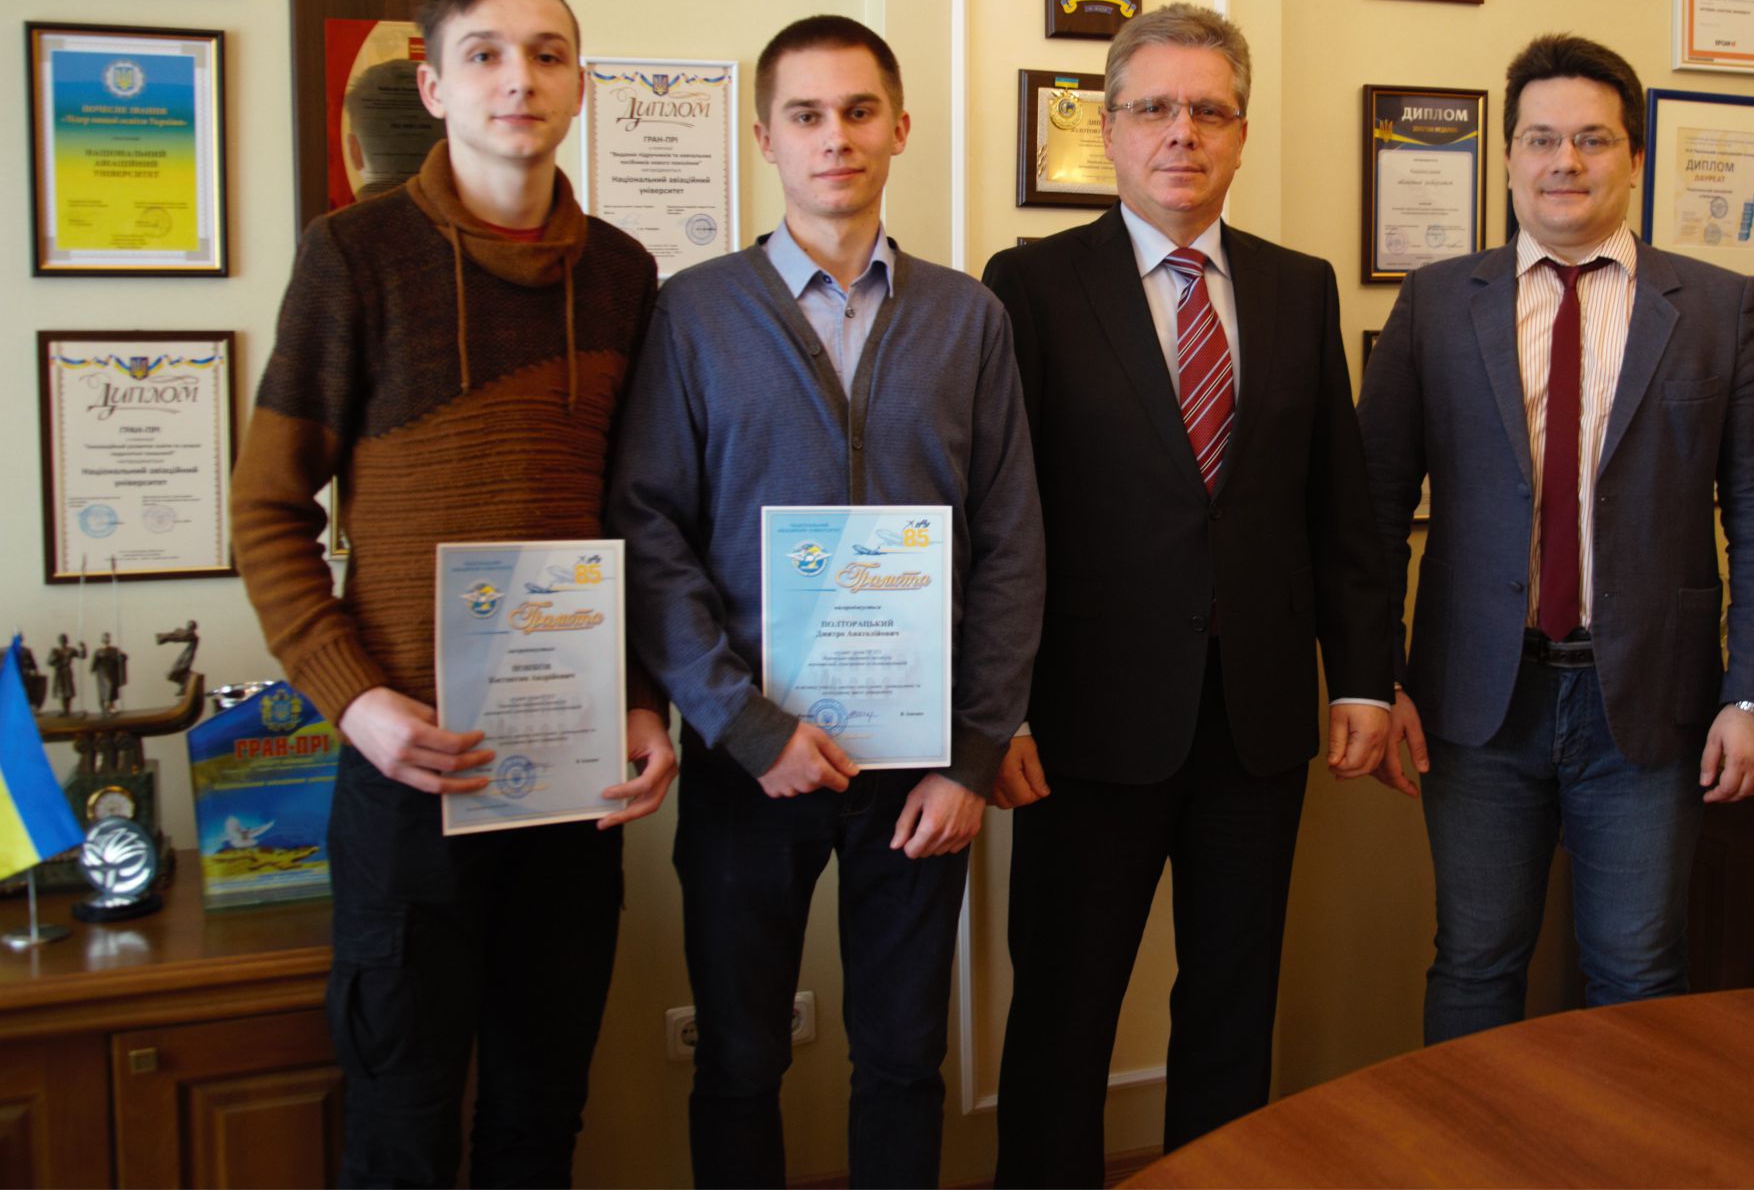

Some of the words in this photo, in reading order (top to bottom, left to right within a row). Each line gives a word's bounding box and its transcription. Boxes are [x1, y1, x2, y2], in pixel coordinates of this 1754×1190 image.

[1401, 107, 1468, 122] ДИПЛОМ
[643, 135, 678, 144] ГРАН-ПРІ
[1686, 158, 1734, 173] ДИПЛОМ
[612, 175, 667, 184] Національний
[669, 176, 711, 185] авіаційний
[1694, 174, 1725, 183] ЛАУРЕАТ
[639, 187, 684, 196] університет
[902, 528, 929, 548] 85
[574, 563, 601, 585] 85
[835, 561, 933, 594] Грамота
[234, 734, 329, 760] ГРАН-ПРІ
